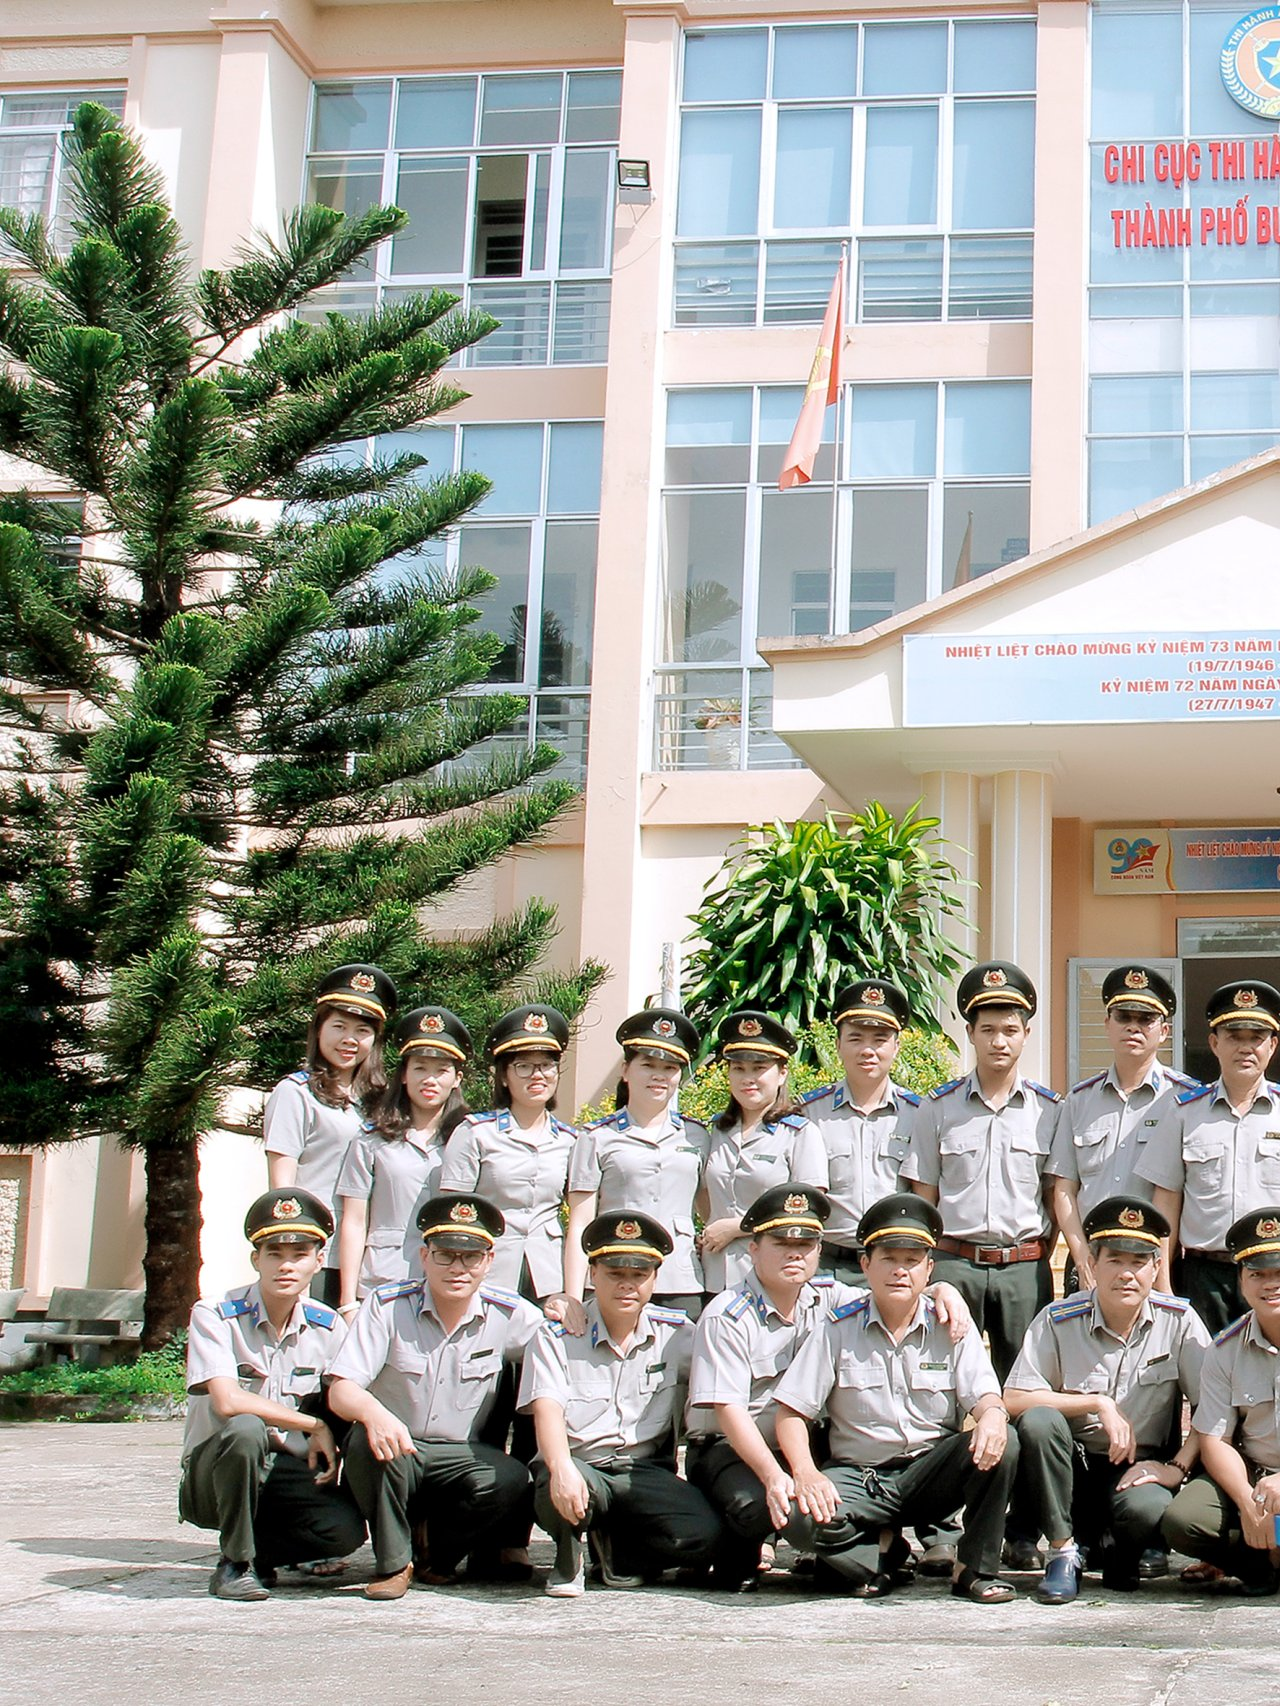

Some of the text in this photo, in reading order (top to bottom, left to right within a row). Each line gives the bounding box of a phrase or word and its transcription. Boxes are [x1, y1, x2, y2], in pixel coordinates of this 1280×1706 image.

[1227, 29, 1243, 47] THI
[1241, 10, 1275, 31] HÀNH
[1104, 144, 1145, 184] CHI
[1154, 143, 1201, 189] CỤC
[1208, 141, 1245, 180] THI
[1111, 202, 1192, 248] THÀNH
[1201, 195, 1250, 246] PHỐ
[945, 644, 992, 660] NHIỆT
[997, 643, 1030, 659] LIỆT
[1034, 641, 1078, 656] CHÀO
[1083, 640, 1132, 655] MỪNG
[1137, 639, 1156, 654] KỶ
[1163, 640, 1204, 656] NIỆM
[1209, 641, 1229, 653] 73
[1234, 638, 1272, 652] NĂM
[1188, 659, 1274, 673] (19/7/1946
[1101, 678, 1122, 693] KỶ
[1127, 679, 1169, 695] NIỆM
[1174, 680, 1194, 692] 72
[1199, 677, 1237, 691] NĂM
[1188, 698, 1274, 712] (27/7/1947
[1186, 841, 1205, 861] NHIỆT
[1207, 840, 1220, 860] LIỆT
[1222, 839, 1239, 857] CHÀO
[1240, 839, 1261, 857] MỪNG
